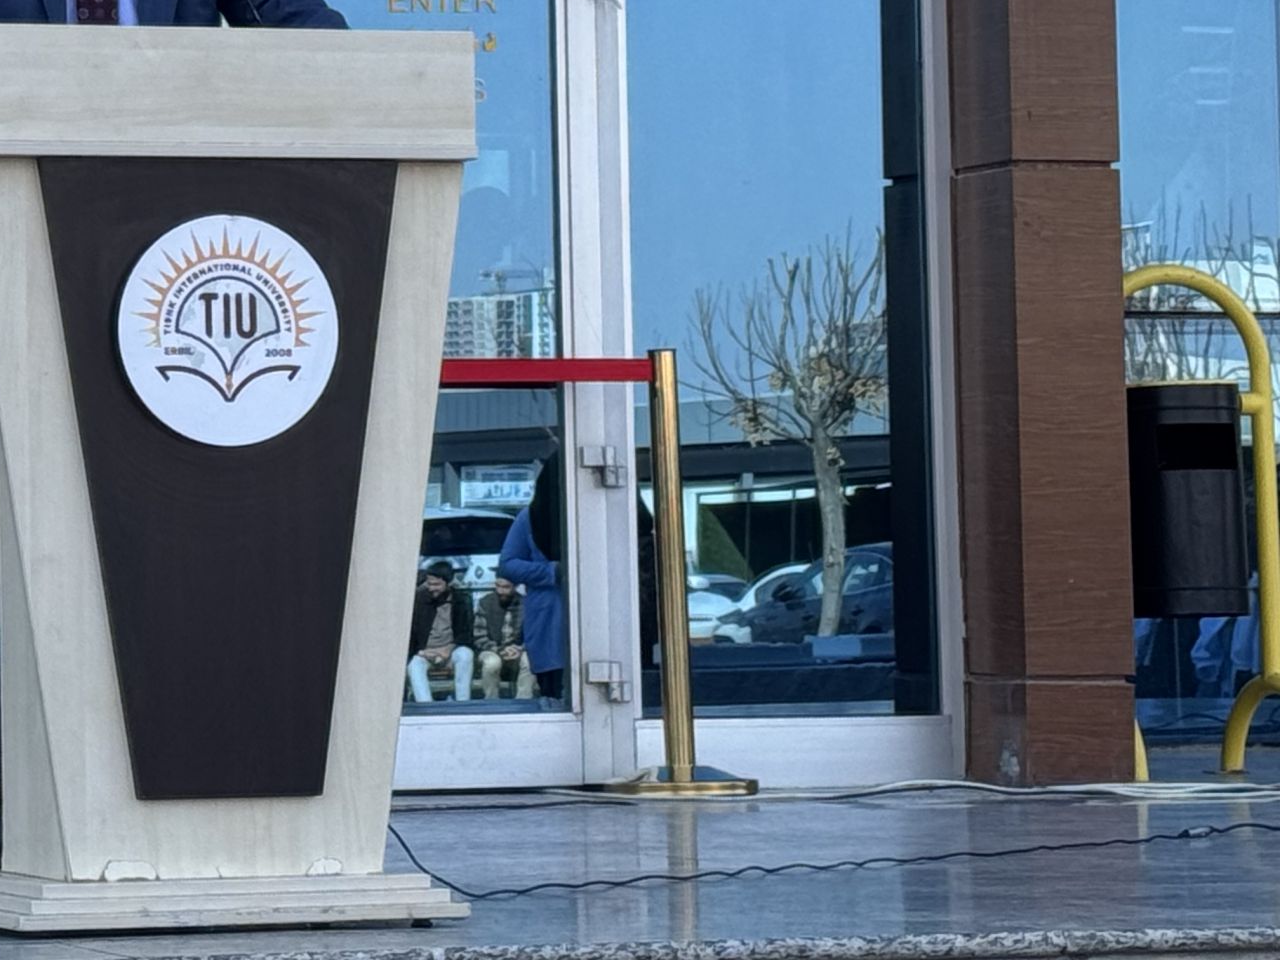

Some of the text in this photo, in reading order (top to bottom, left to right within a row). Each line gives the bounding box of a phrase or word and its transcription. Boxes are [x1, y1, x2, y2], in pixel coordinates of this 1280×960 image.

[173, 263, 253, 299] INTERNATIONAL
[255, 274, 292, 333] UNIVERSITY
[199, 292, 257, 338] TIU
[264, 348, 293, 358] 2008
